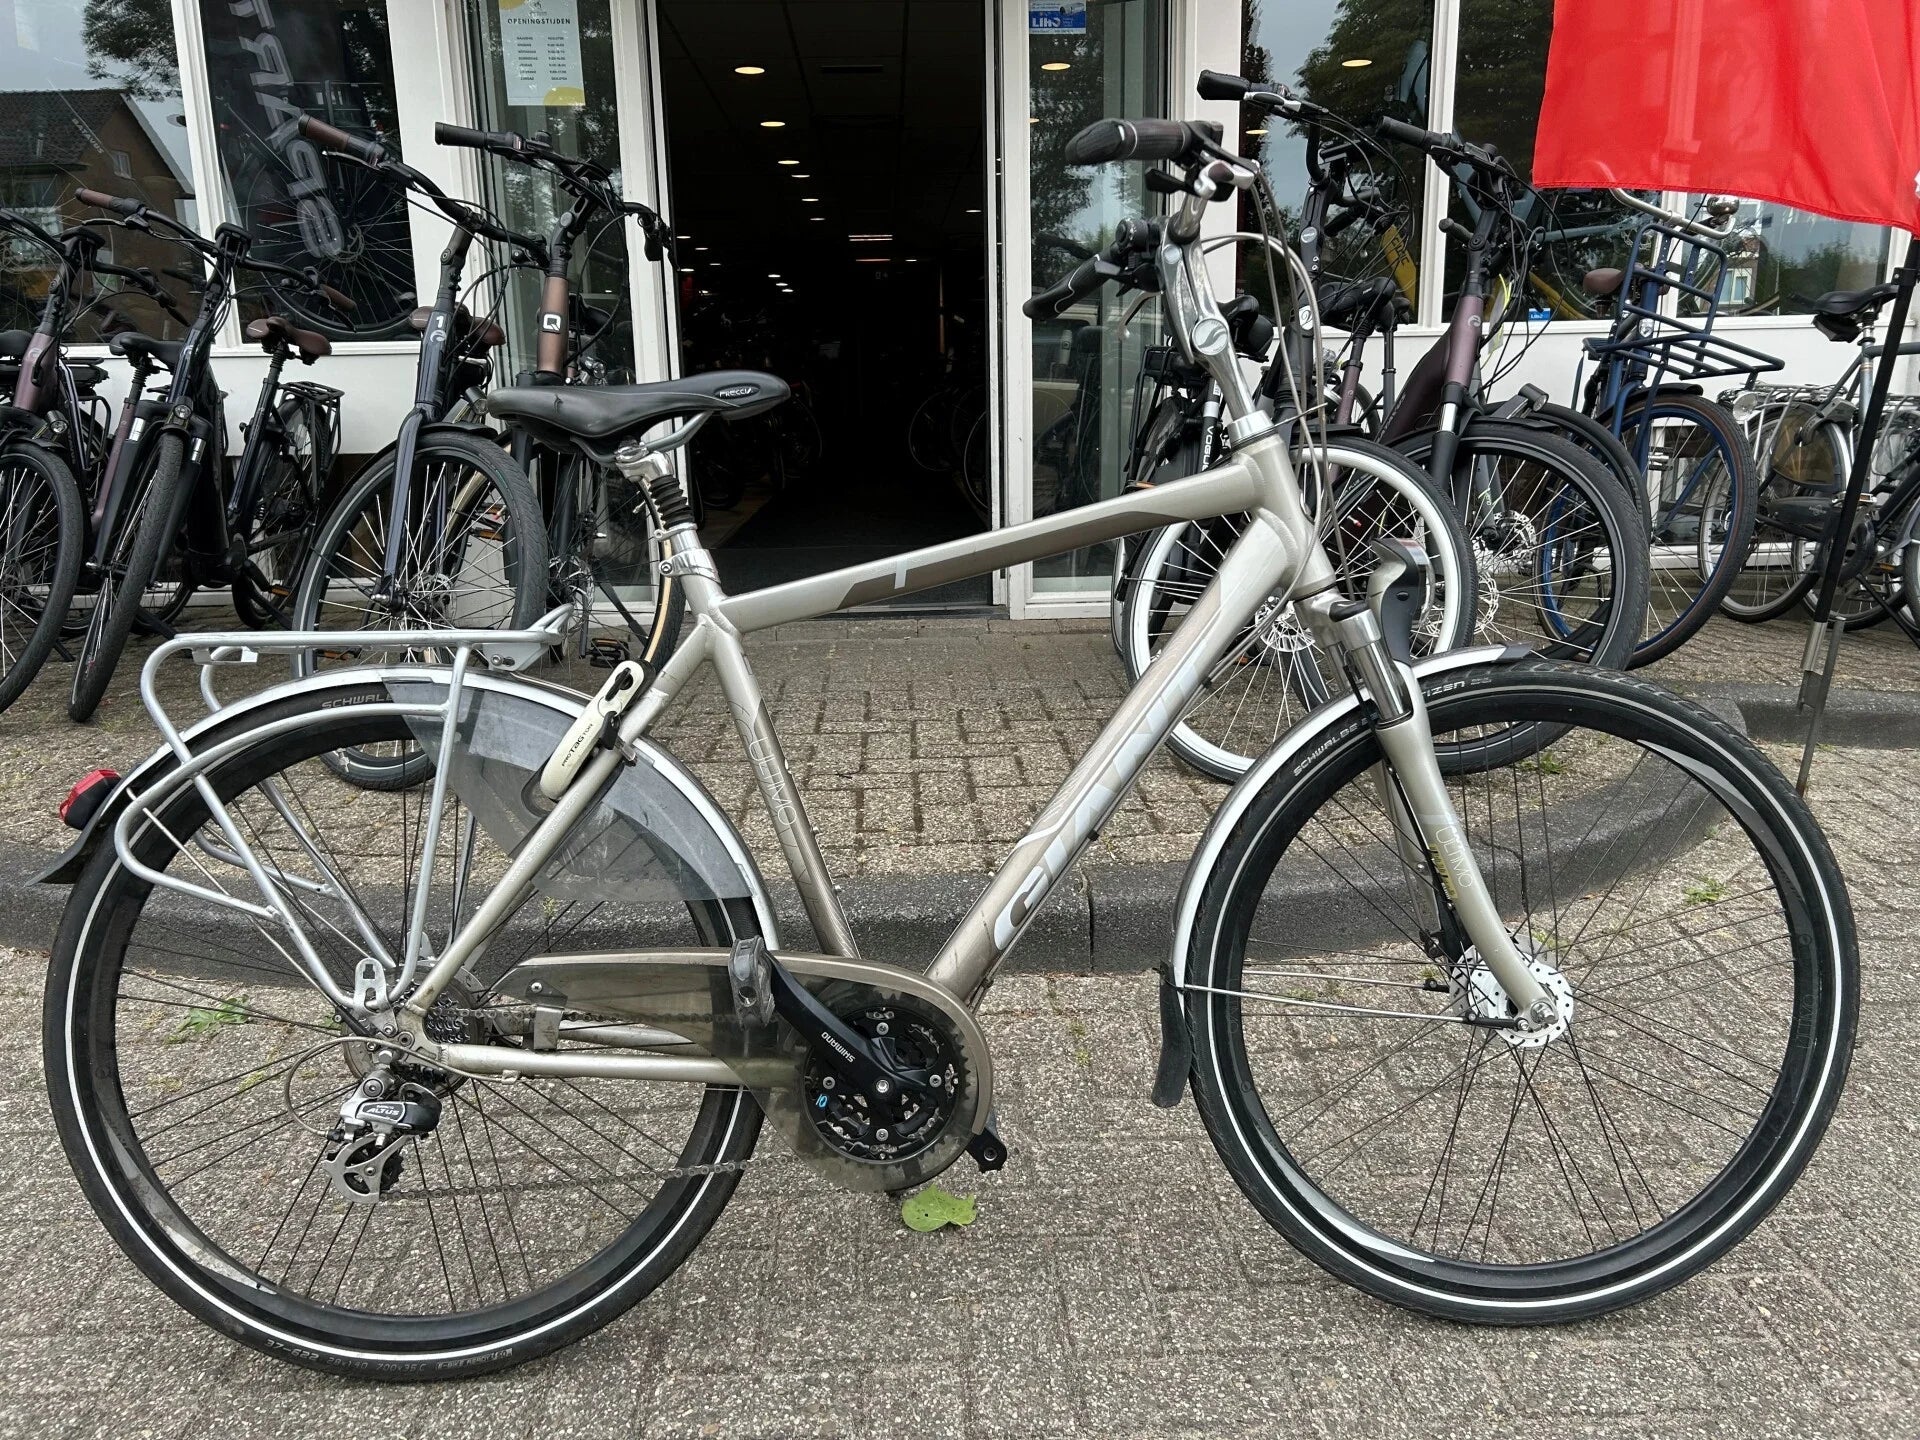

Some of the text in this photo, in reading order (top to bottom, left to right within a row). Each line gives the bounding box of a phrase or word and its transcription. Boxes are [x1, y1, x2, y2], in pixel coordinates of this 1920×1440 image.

[72, 118, 105, 154] BATAVUS
[1293, 721, 1359, 777] SCHWALBE
[749, 737, 797, 826] ULTIMO
[993, 638, 1208, 951] GIANT
[1435, 826, 1474, 888] ULTIMO
[821, 1031, 856, 1063] SHIMANO
[366, 1107, 400, 1116] ALTUS
[264, 1338, 319, 1362] 37-622
